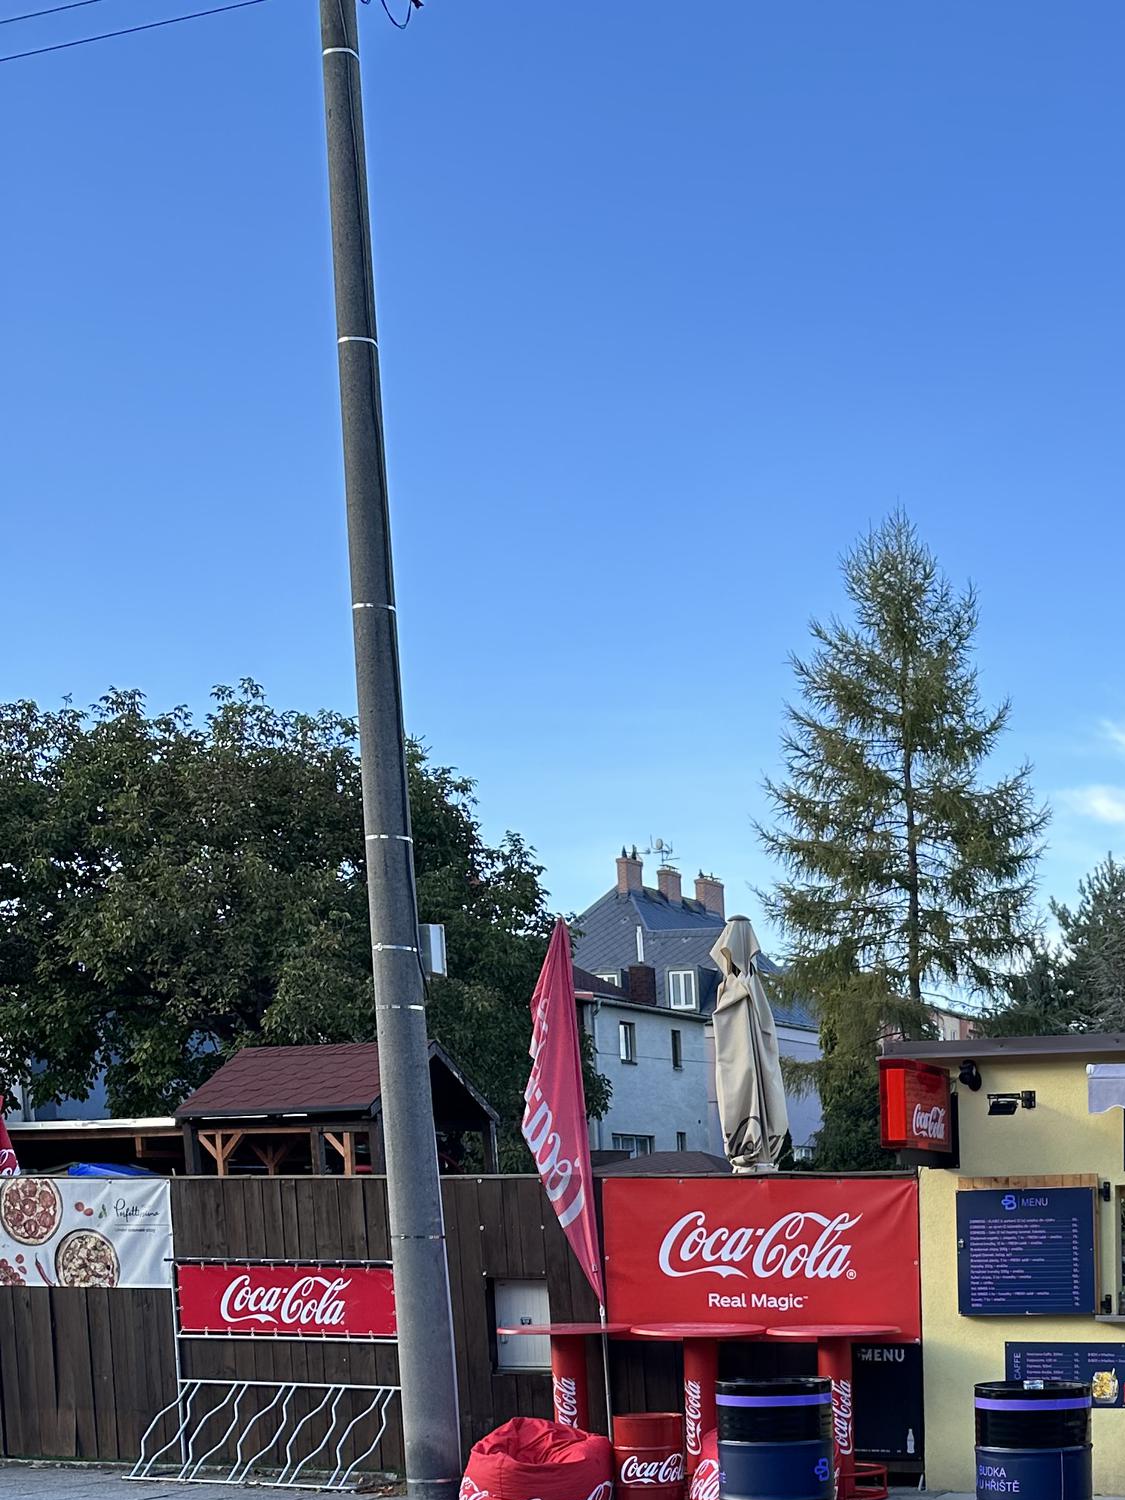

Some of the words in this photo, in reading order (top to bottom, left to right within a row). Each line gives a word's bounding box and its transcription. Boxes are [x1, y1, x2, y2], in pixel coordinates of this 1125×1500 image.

[912, 1103, 946, 1139] Coca-Cola
[1021, 1197, 1048, 1207] MENU
[220, 1274, 352, 1325] Coca-Cola
[708, 1293, 747, 1308] Real
[860, 1348, 905, 1363] MENU
